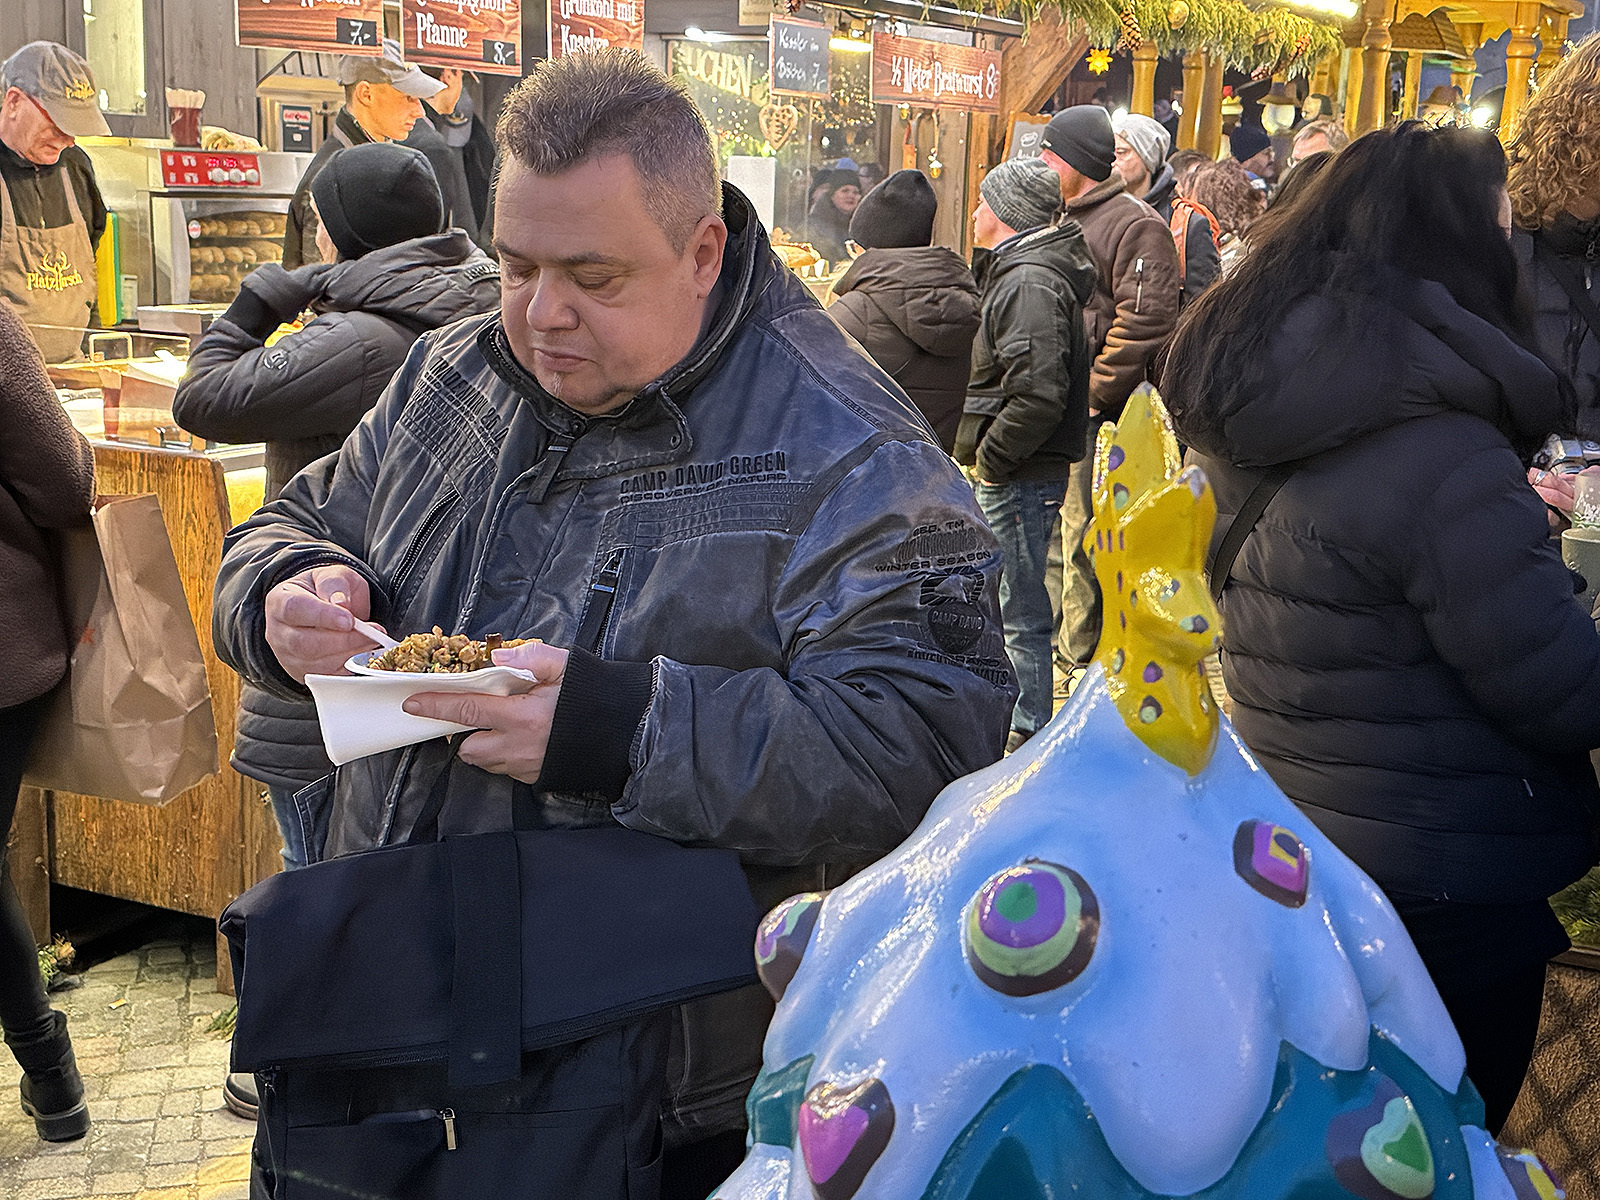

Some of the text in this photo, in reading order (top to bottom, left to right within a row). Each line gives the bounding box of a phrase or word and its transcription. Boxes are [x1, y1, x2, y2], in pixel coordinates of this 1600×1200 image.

[617, 0, 637, 26] mit
[416, 12, 468, 49] Pfanne
[903, 57, 932, 94] Meter
[933, 61, 983, 99] Bratwurst
[620, 450, 786, 494] CAMP DAVID GREEN
[620, 486, 702, 504] DISCOVERY
[728, 473, 787, 486] NATURE
[946, 520, 964, 530] TM
[875, 550, 992, 572] WINTER SEASON
